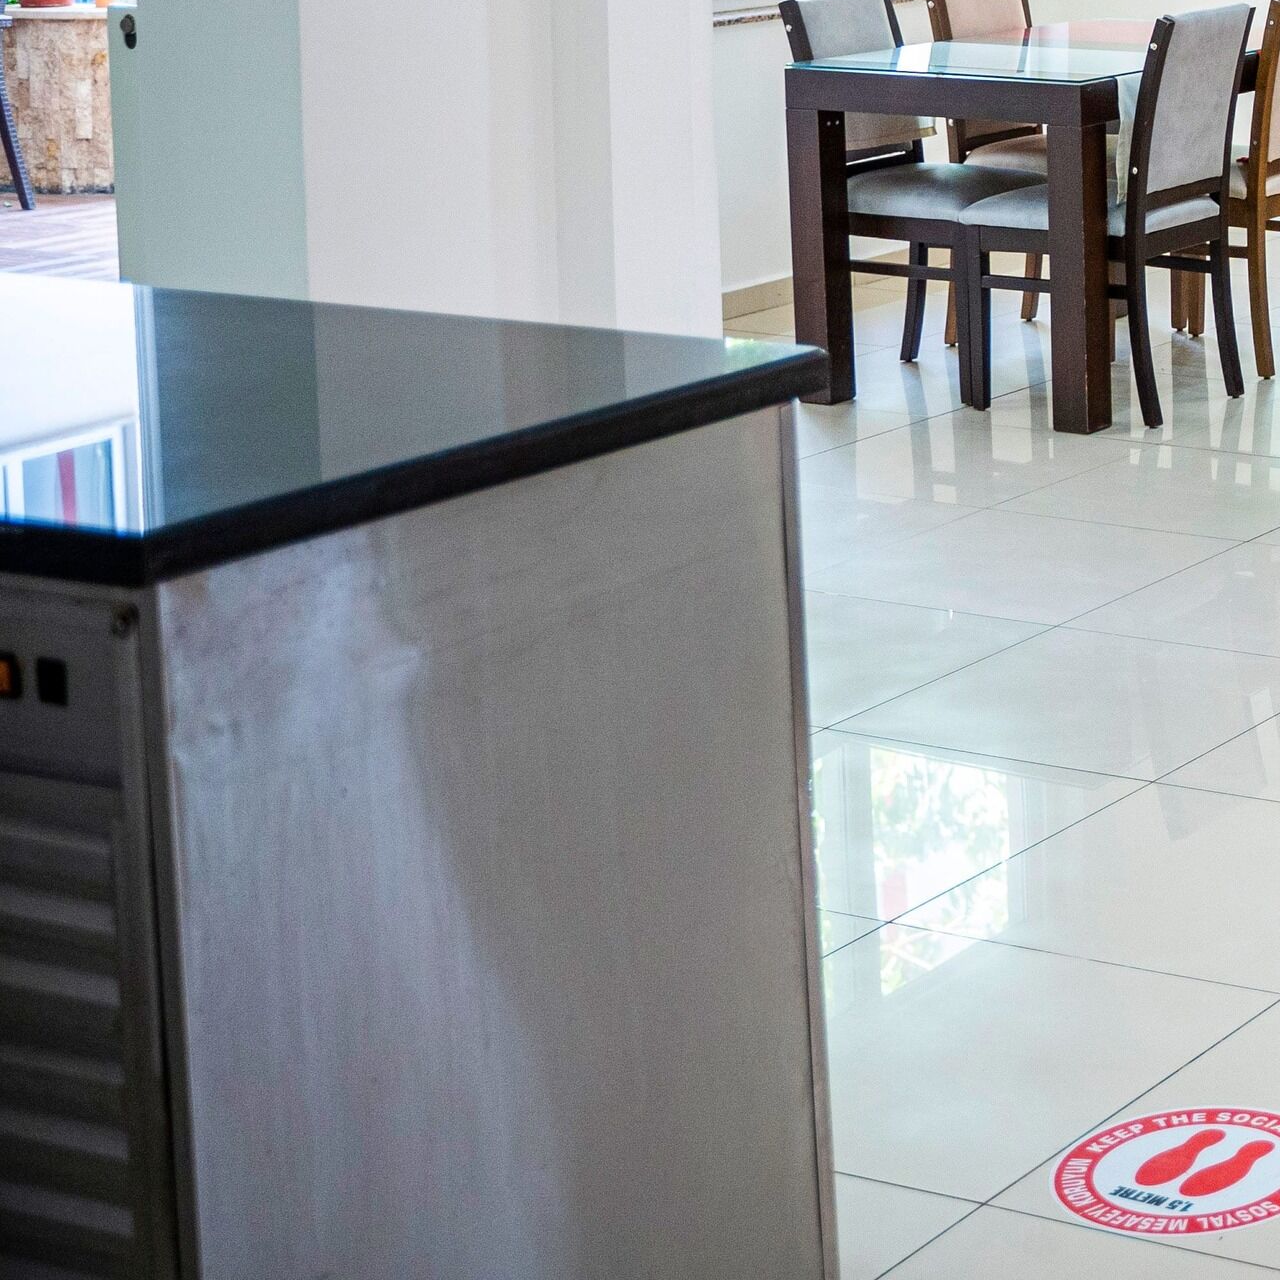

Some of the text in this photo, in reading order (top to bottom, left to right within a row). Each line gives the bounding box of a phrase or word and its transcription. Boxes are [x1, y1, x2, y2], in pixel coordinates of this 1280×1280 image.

[1087, 1123, 1144, 1153] KEEP
[1152, 1112, 1206, 1127] THE
[1061, 1157, 1095, 1208] KORUYUN
[1108, 1185, 1195, 1213] 1,5 METRE
[1197, 1201, 1280, 1229] SOSYAL
